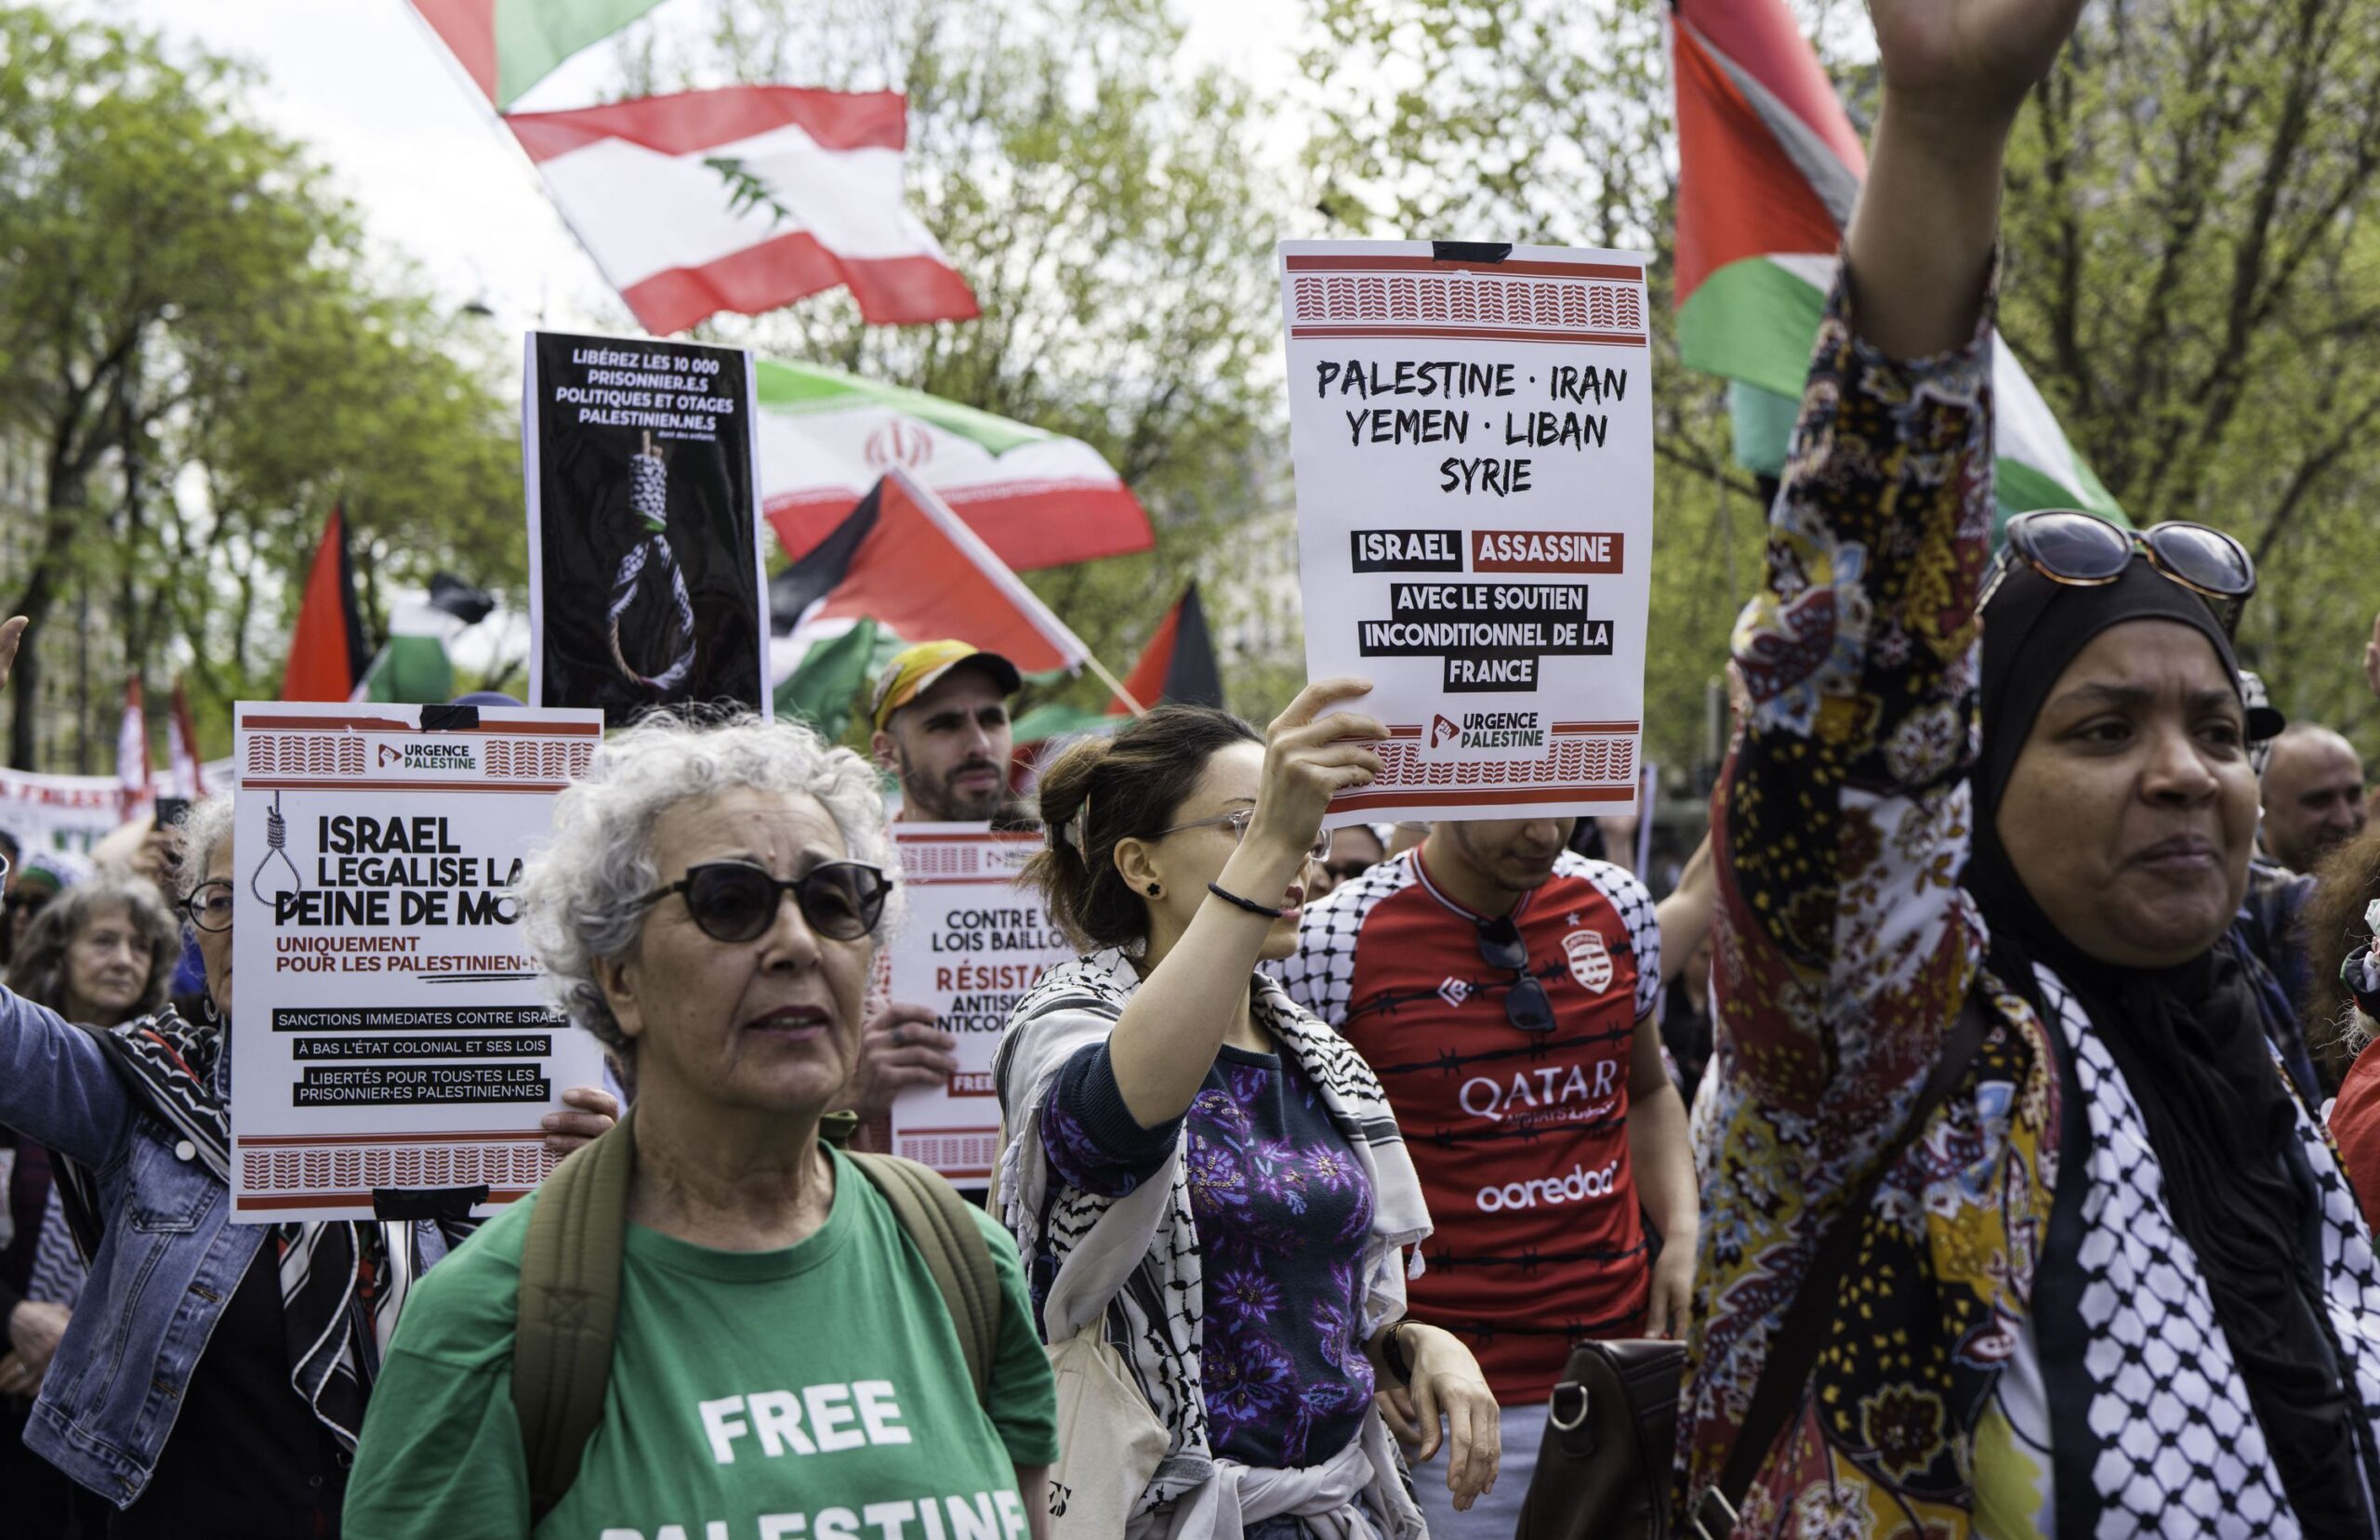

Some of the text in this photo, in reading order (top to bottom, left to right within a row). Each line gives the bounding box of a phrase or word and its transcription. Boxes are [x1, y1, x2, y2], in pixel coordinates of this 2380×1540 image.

[573, 348, 720, 375] LIBÉREZ LES 10 000
[588, 369, 708, 392] PRISONNIER.E.S
[1316, 360, 1515, 400] PALESTINE
[1551, 365, 1628, 405] IRAN
[556, 388, 734, 414] POLITIQUES ET OTAGES
[579, 408, 716, 431] PALESTINIEN.NE.S
[1345, 409, 1469, 447] YEMEN
[1505, 411, 1607, 452] LIBAN
[1440, 457, 1531, 497] SYRIE
[1358, 533, 1612, 562] ISRAEL ASSASSINE
[1397, 586, 1583, 610] AVEC LE SOUTIEN
[1365, 624, 1609, 647] INCONDITIONNEL DE LA
[1449, 660, 1533, 683] FRANCE
[1462, 712, 1539, 730] URGENCE
[404, 744, 469, 757] URGENCE
[1461, 730, 1543, 748] PALESTINE
[404, 757, 476, 770] PALESTINE
[319, 816, 460, 854] ISRAEL
[275, 890, 525, 926] PEINE DE MO
[946, 909, 1037, 929] CONTRE
[276, 936, 420, 955] UNIQUEMENT
[932, 930, 1070, 952] LOIS BAILLO
[276, 956, 336, 972] POUR
[341, 956, 381, 972] LES
[937, 958, 1045, 991] RÉSISTA
[278, 1011, 565, 1026] SANCTIONS IMMEDIATES CONTRE ISRAEL
[298, 1039, 309, 1055] À
[312, 1043, 340, 1055] BAS
[393, 1041, 461, 1053] COLONIAL
[466, 1041, 483, 1052] ET
[486, 1041, 512, 1052] SES
[516, 1040, 546, 1051] LOIS
[311, 1069, 535, 1085] LIBERTÉS POUR TOUS·TES LES
[300, 1085, 544, 1100] PRISONNIER·ES PALESTINIEN·NES
[1459, 1060, 1617, 1122] QATAR
[698, 1379, 912, 1465] FREE
